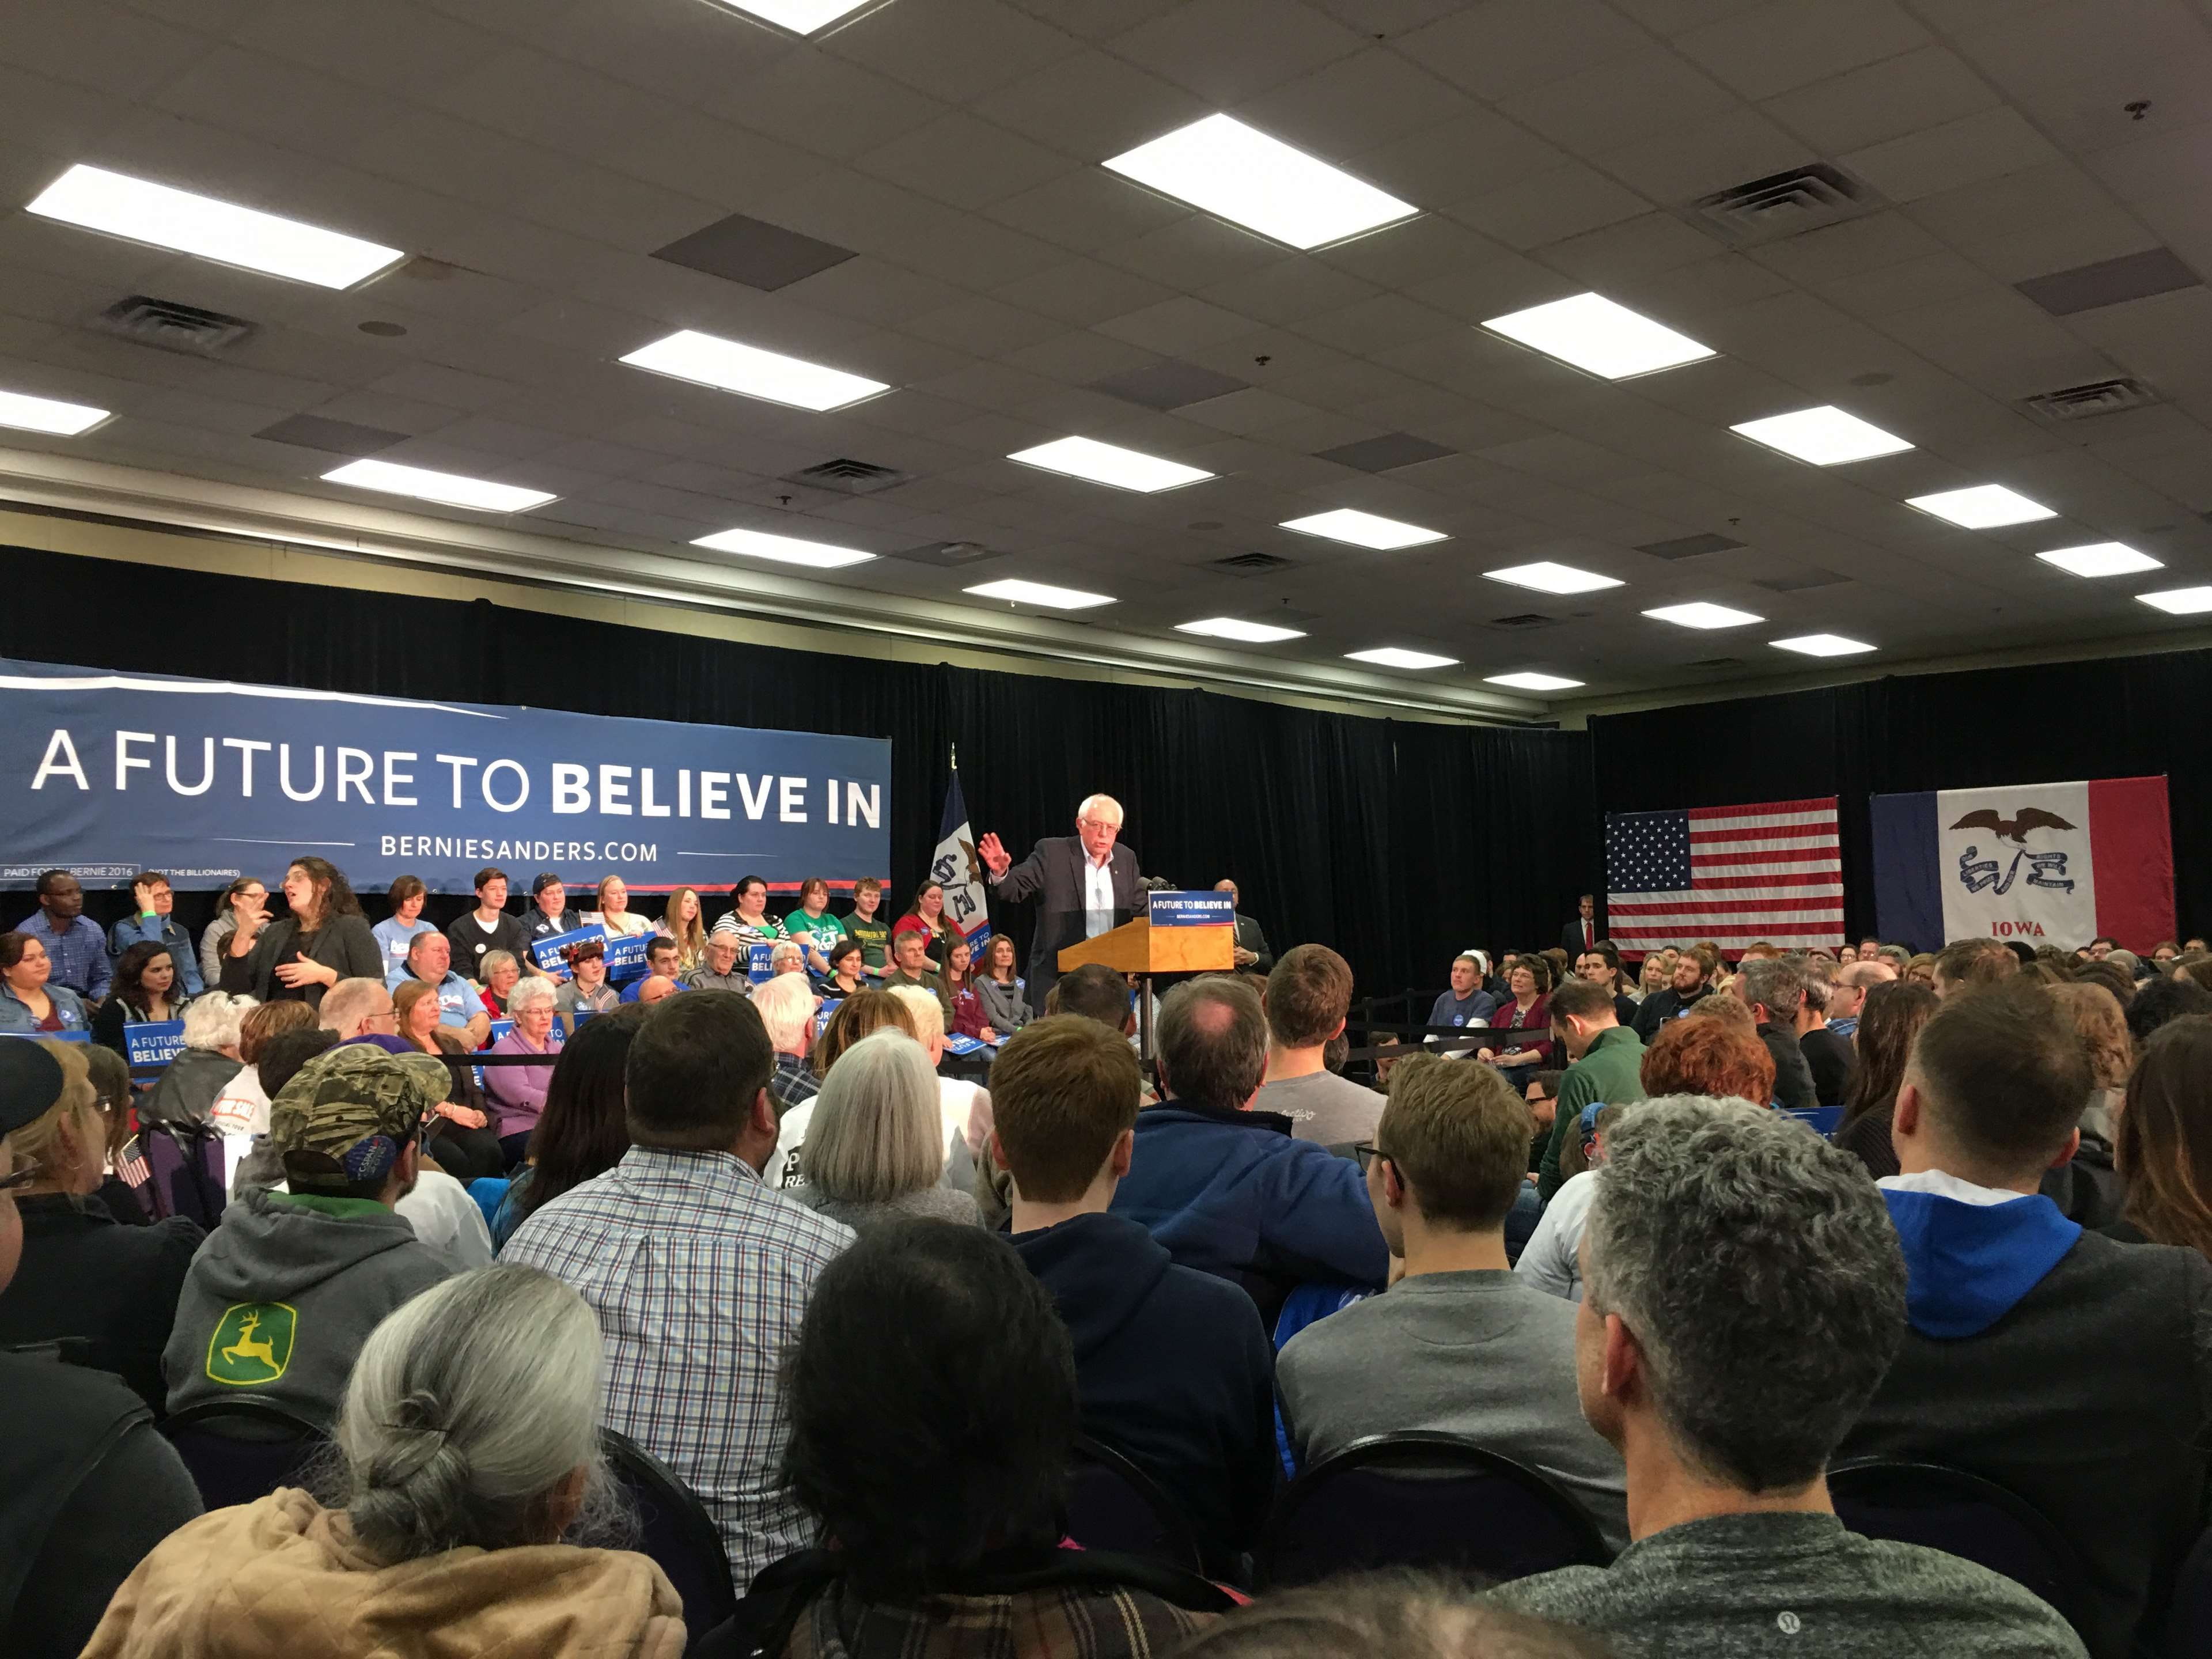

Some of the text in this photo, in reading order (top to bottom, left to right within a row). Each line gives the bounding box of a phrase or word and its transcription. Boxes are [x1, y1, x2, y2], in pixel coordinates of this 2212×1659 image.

[31, 729, 880, 828] A FUTURE TO BELIEVE IN
[381, 835, 657, 862] BERNIESANDERS.COM
[3, 868, 30, 877] PAID
[70, 867, 107, 876] BERNIE
[108, 867, 133, 876] 2016
[187, 869, 240, 878] BILLIONAIRES)
[1153, 900, 1232, 909] A FUTURE TO BELIEVE IN
[1991, 921, 2046, 937] IOWA
[979, 931, 990, 941] TO
[981, 937, 990, 948] IN
[540, 950, 547, 959] A
[615, 943, 649, 956] A FUTU
[752, 953, 759, 961] A
[131, 1038, 140, 1048] A
[133, 1047, 187, 1063] BELIEV
